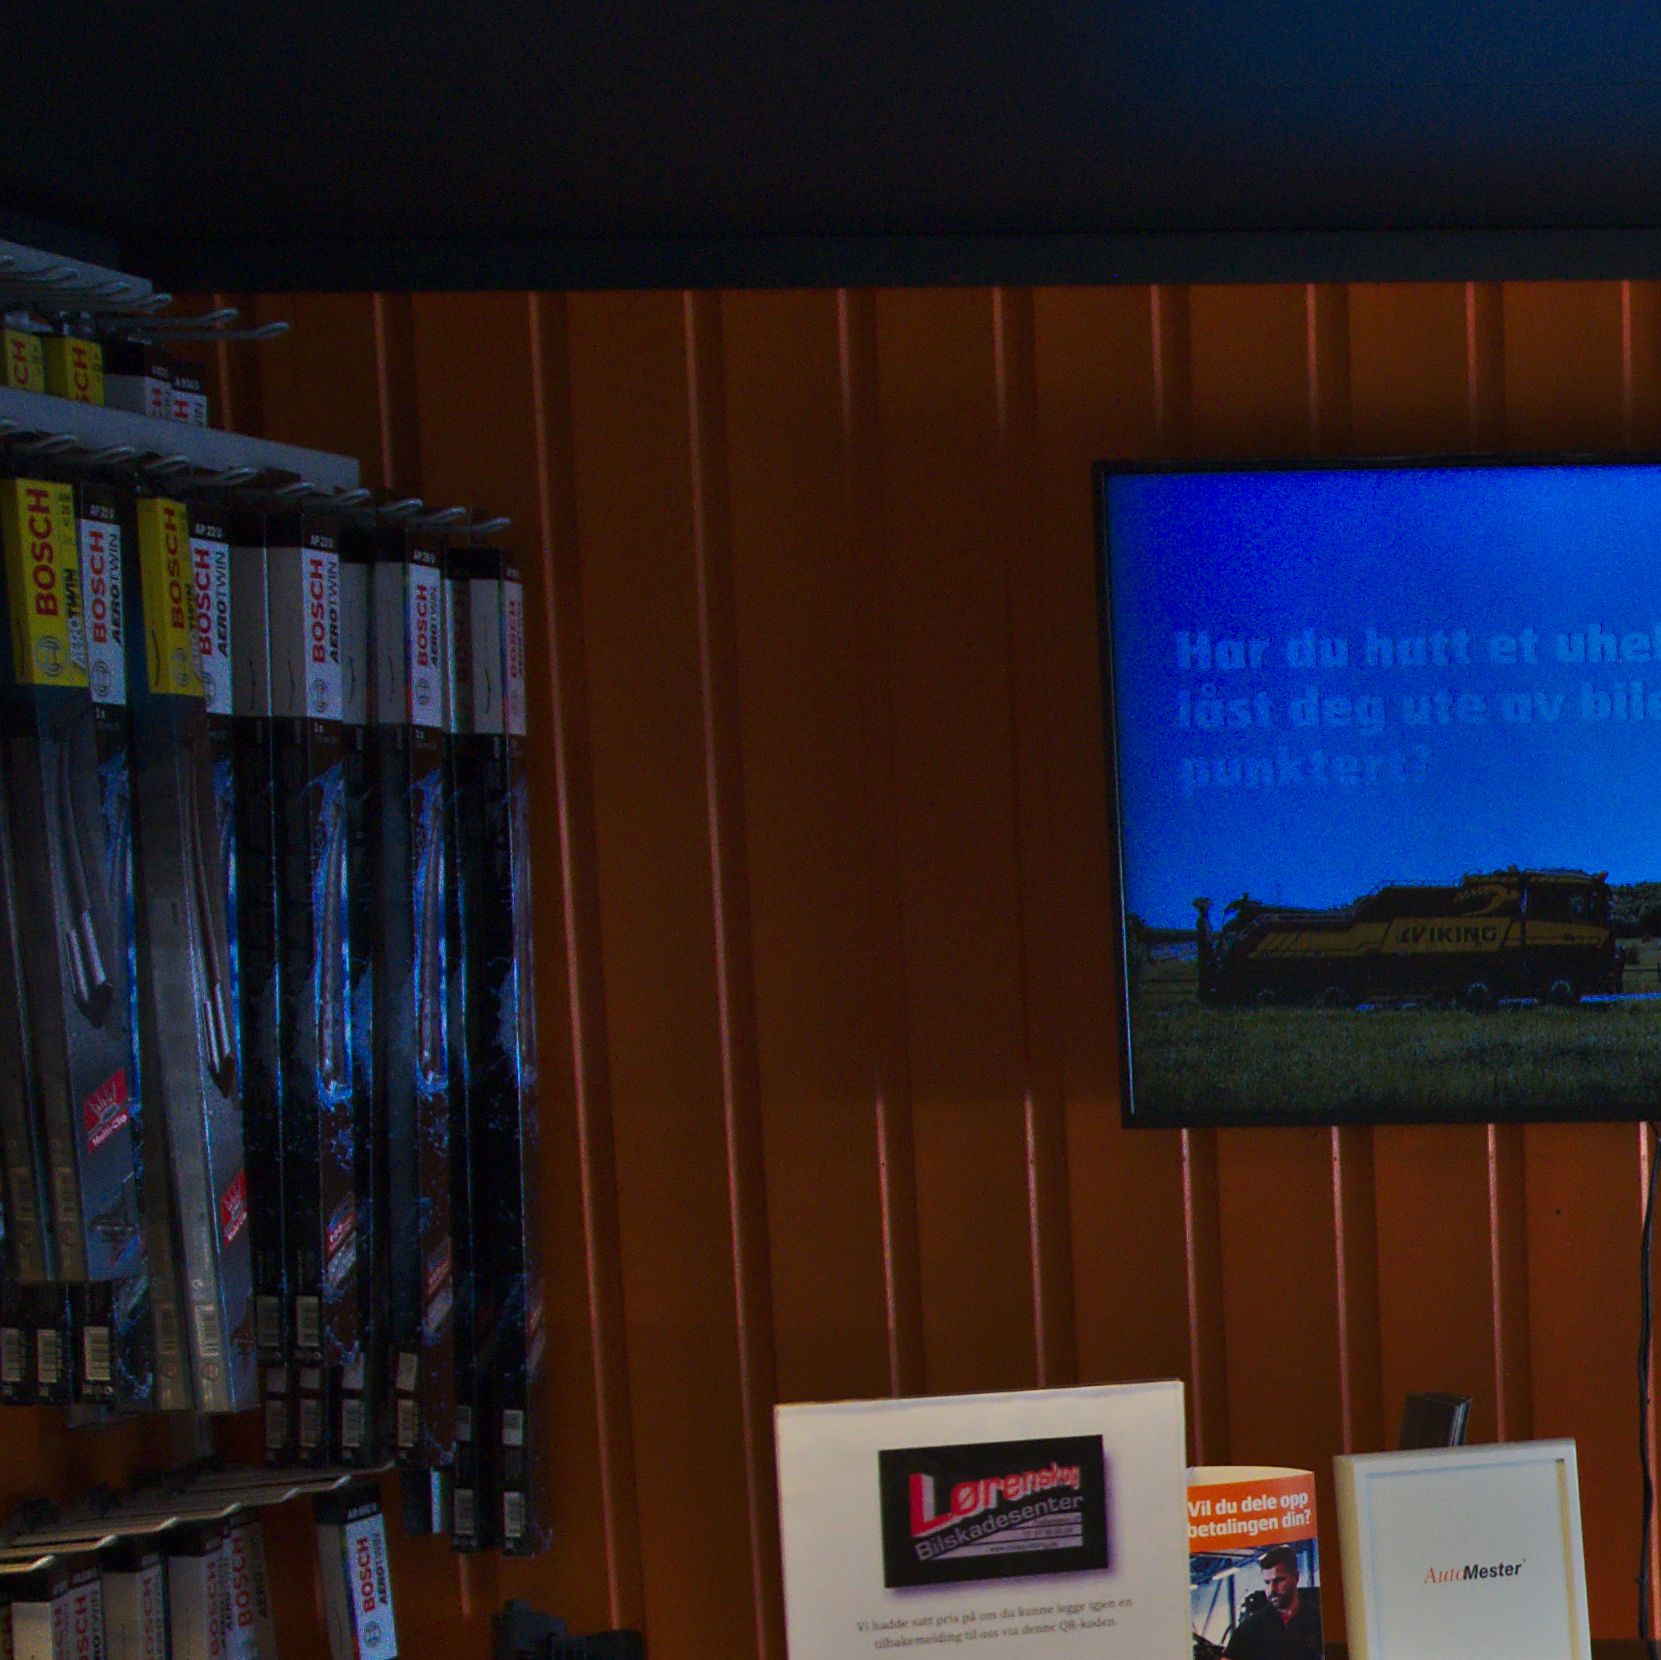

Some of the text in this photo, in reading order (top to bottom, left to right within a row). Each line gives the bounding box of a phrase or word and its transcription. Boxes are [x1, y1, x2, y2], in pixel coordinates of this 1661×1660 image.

[26, 487, 59, 617] BOSCH
[89, 530, 108, 643] BOSCH
[107, 532, 122, 644] AEROTWIN
[163, 507, 184, 630] BOSCH
[193, 547, 213, 656] BOSCH
[215, 552, 229, 657] AEROTWIN
[309, 558, 326, 664] BOSCH
[327, 560, 340, 665] AEROTWIN
[415, 584, 428, 667] BOSCH
[1178, 630, 1270, 670] Har
[1286, 628, 1349, 667] du
[1365, 624, 1472, 664] hatt
[1489, 626, 1537, 663] et
[1176, 684, 1274, 732] låst
[1290, 687, 1386, 734] deg
[1404, 687, 1484, 726] ute
[1502, 690, 1564, 723] av
[908, 1461, 1081, 1538] Lørenskog
[912, 1494, 1085, 1561] Bilskadesenter
[1187, 1509, 1311, 1539] betalingen din?
[1188, 1492, 1309, 1517] Vil du dele opp
[233, 1538, 253, 1627] BOSCH
[356, 1537, 376, 1613] BOSCH
[1423, 1562, 1522, 1585] AutoMester
[856, 1598, 1133, 1632] Vi hadde satt pris på om du kunne legge igjen en
[874, 1631, 962, 1650] tilbakemelding
[965, 1629, 977, 1642] til
[980, 1628, 999, 1639] oss
[1002, 1625, 1018, 1637] via
[1021, 1622, 1056, 1636] denne
